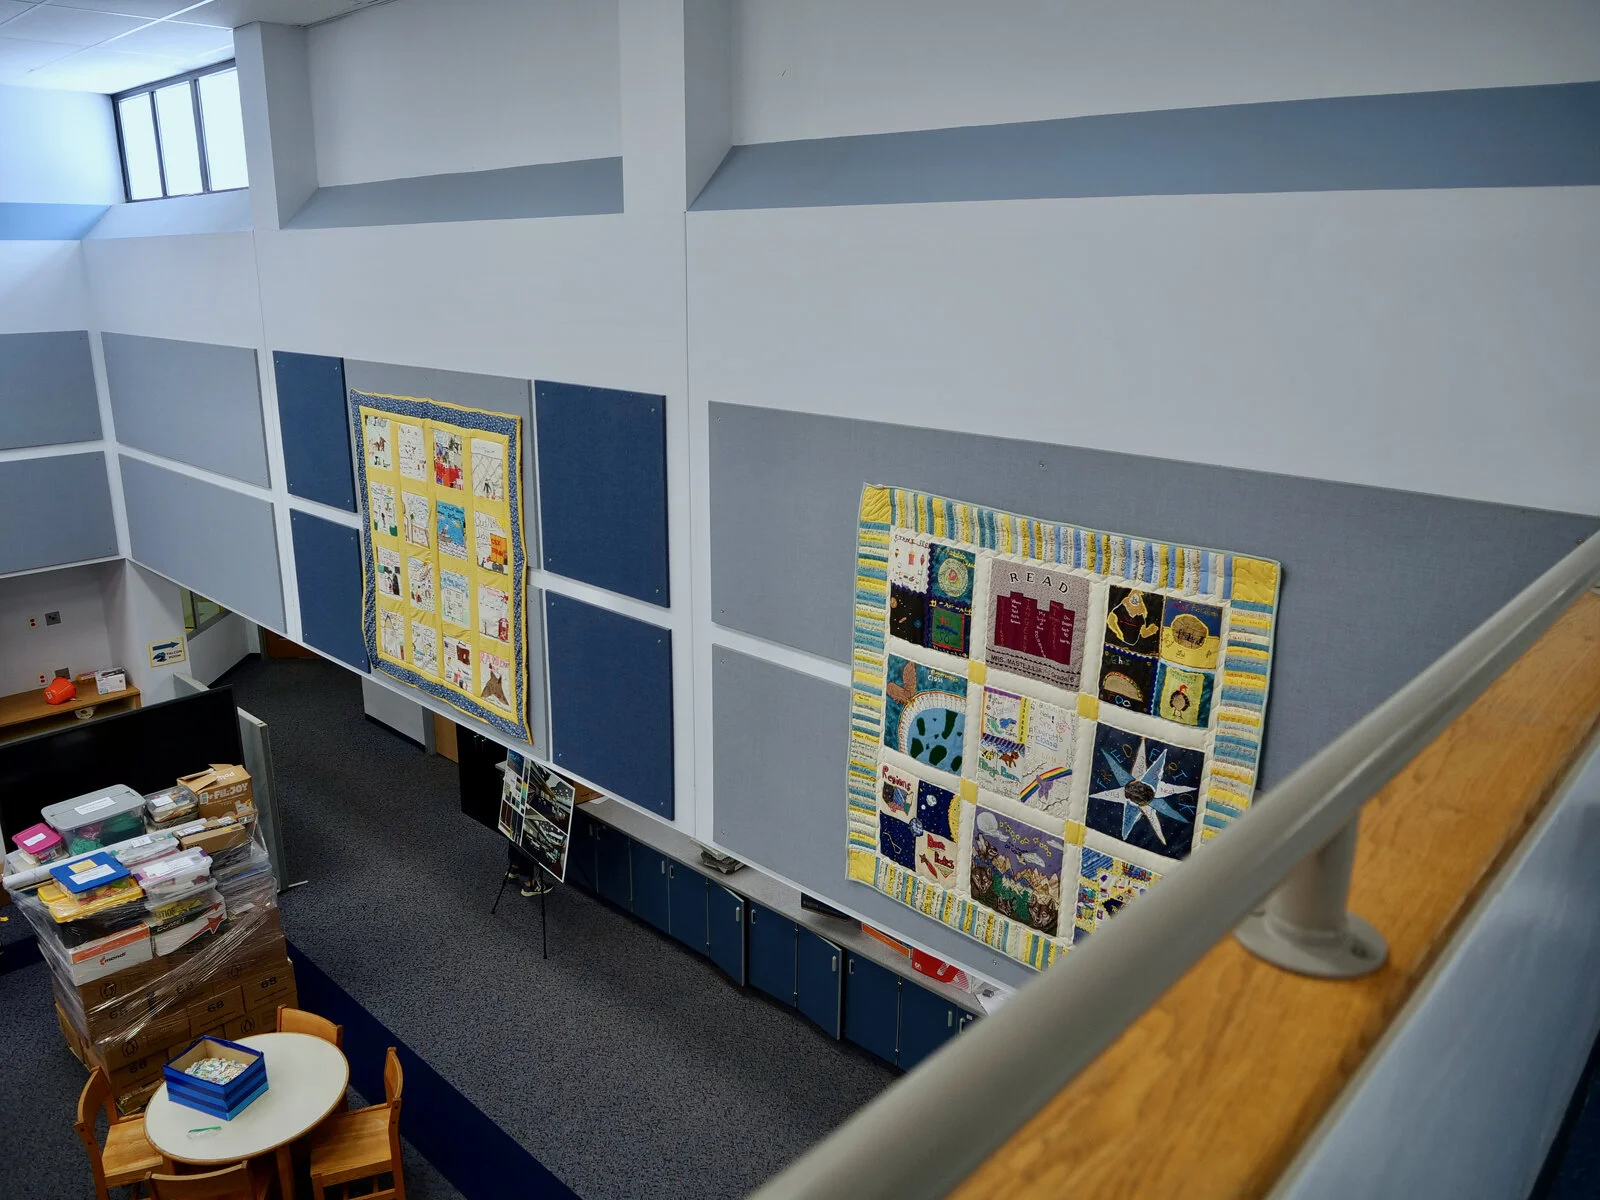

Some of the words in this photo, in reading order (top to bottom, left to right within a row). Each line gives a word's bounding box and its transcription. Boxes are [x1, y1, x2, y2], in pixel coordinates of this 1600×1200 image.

[1009, 572, 1069, 594] READ
[882, 765, 911, 791] Regions
[260, 976, 277, 988] 68
[207, 1000, 224, 1013] 68
